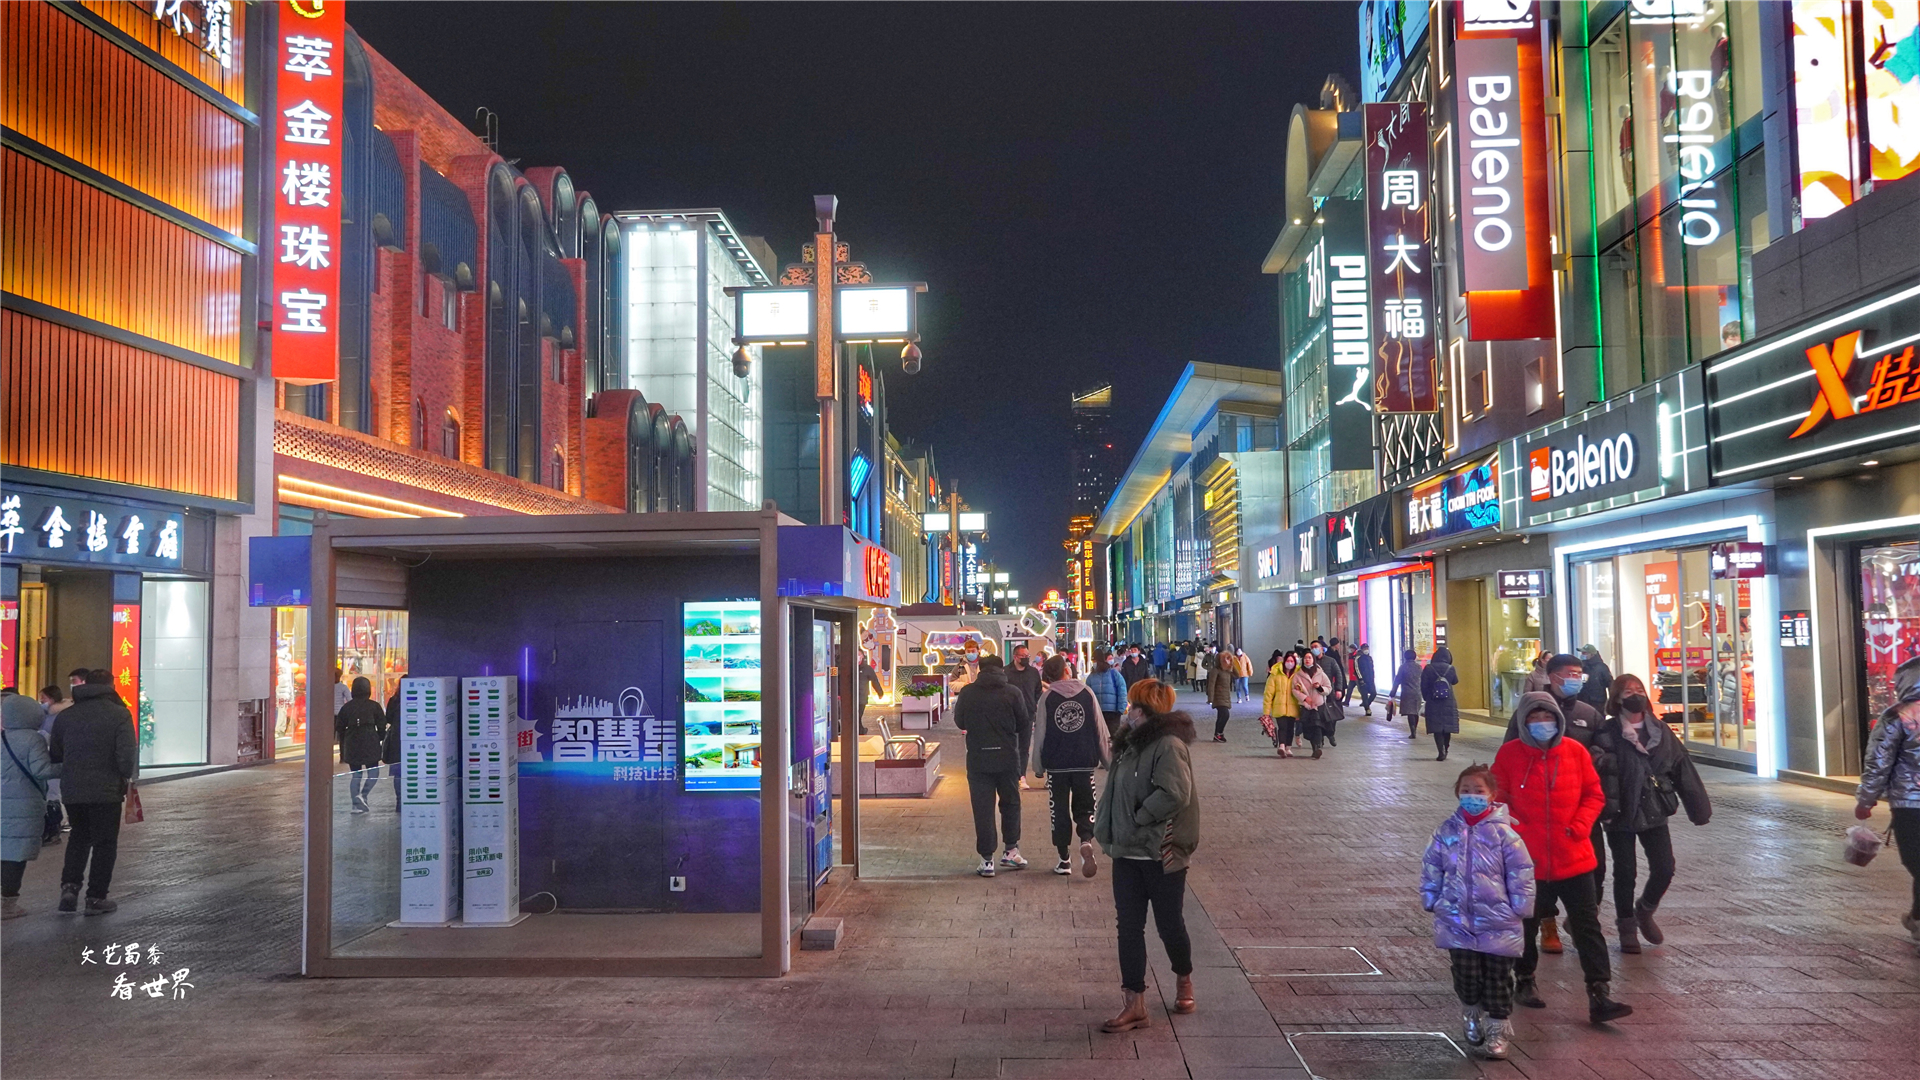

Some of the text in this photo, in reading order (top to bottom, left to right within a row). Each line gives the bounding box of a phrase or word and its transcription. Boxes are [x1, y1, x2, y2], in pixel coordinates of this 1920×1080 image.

[280, 35, 333, 333] 萃金楼珠宝
[1467, 75, 1520, 252] Baleno
[1381, 170, 1425, 339] 周大福
[1408, 492, 1444, 535] 周大福
[1551, 432, 1634, 498] Baleno
[518, 731, 534, 747] 街
